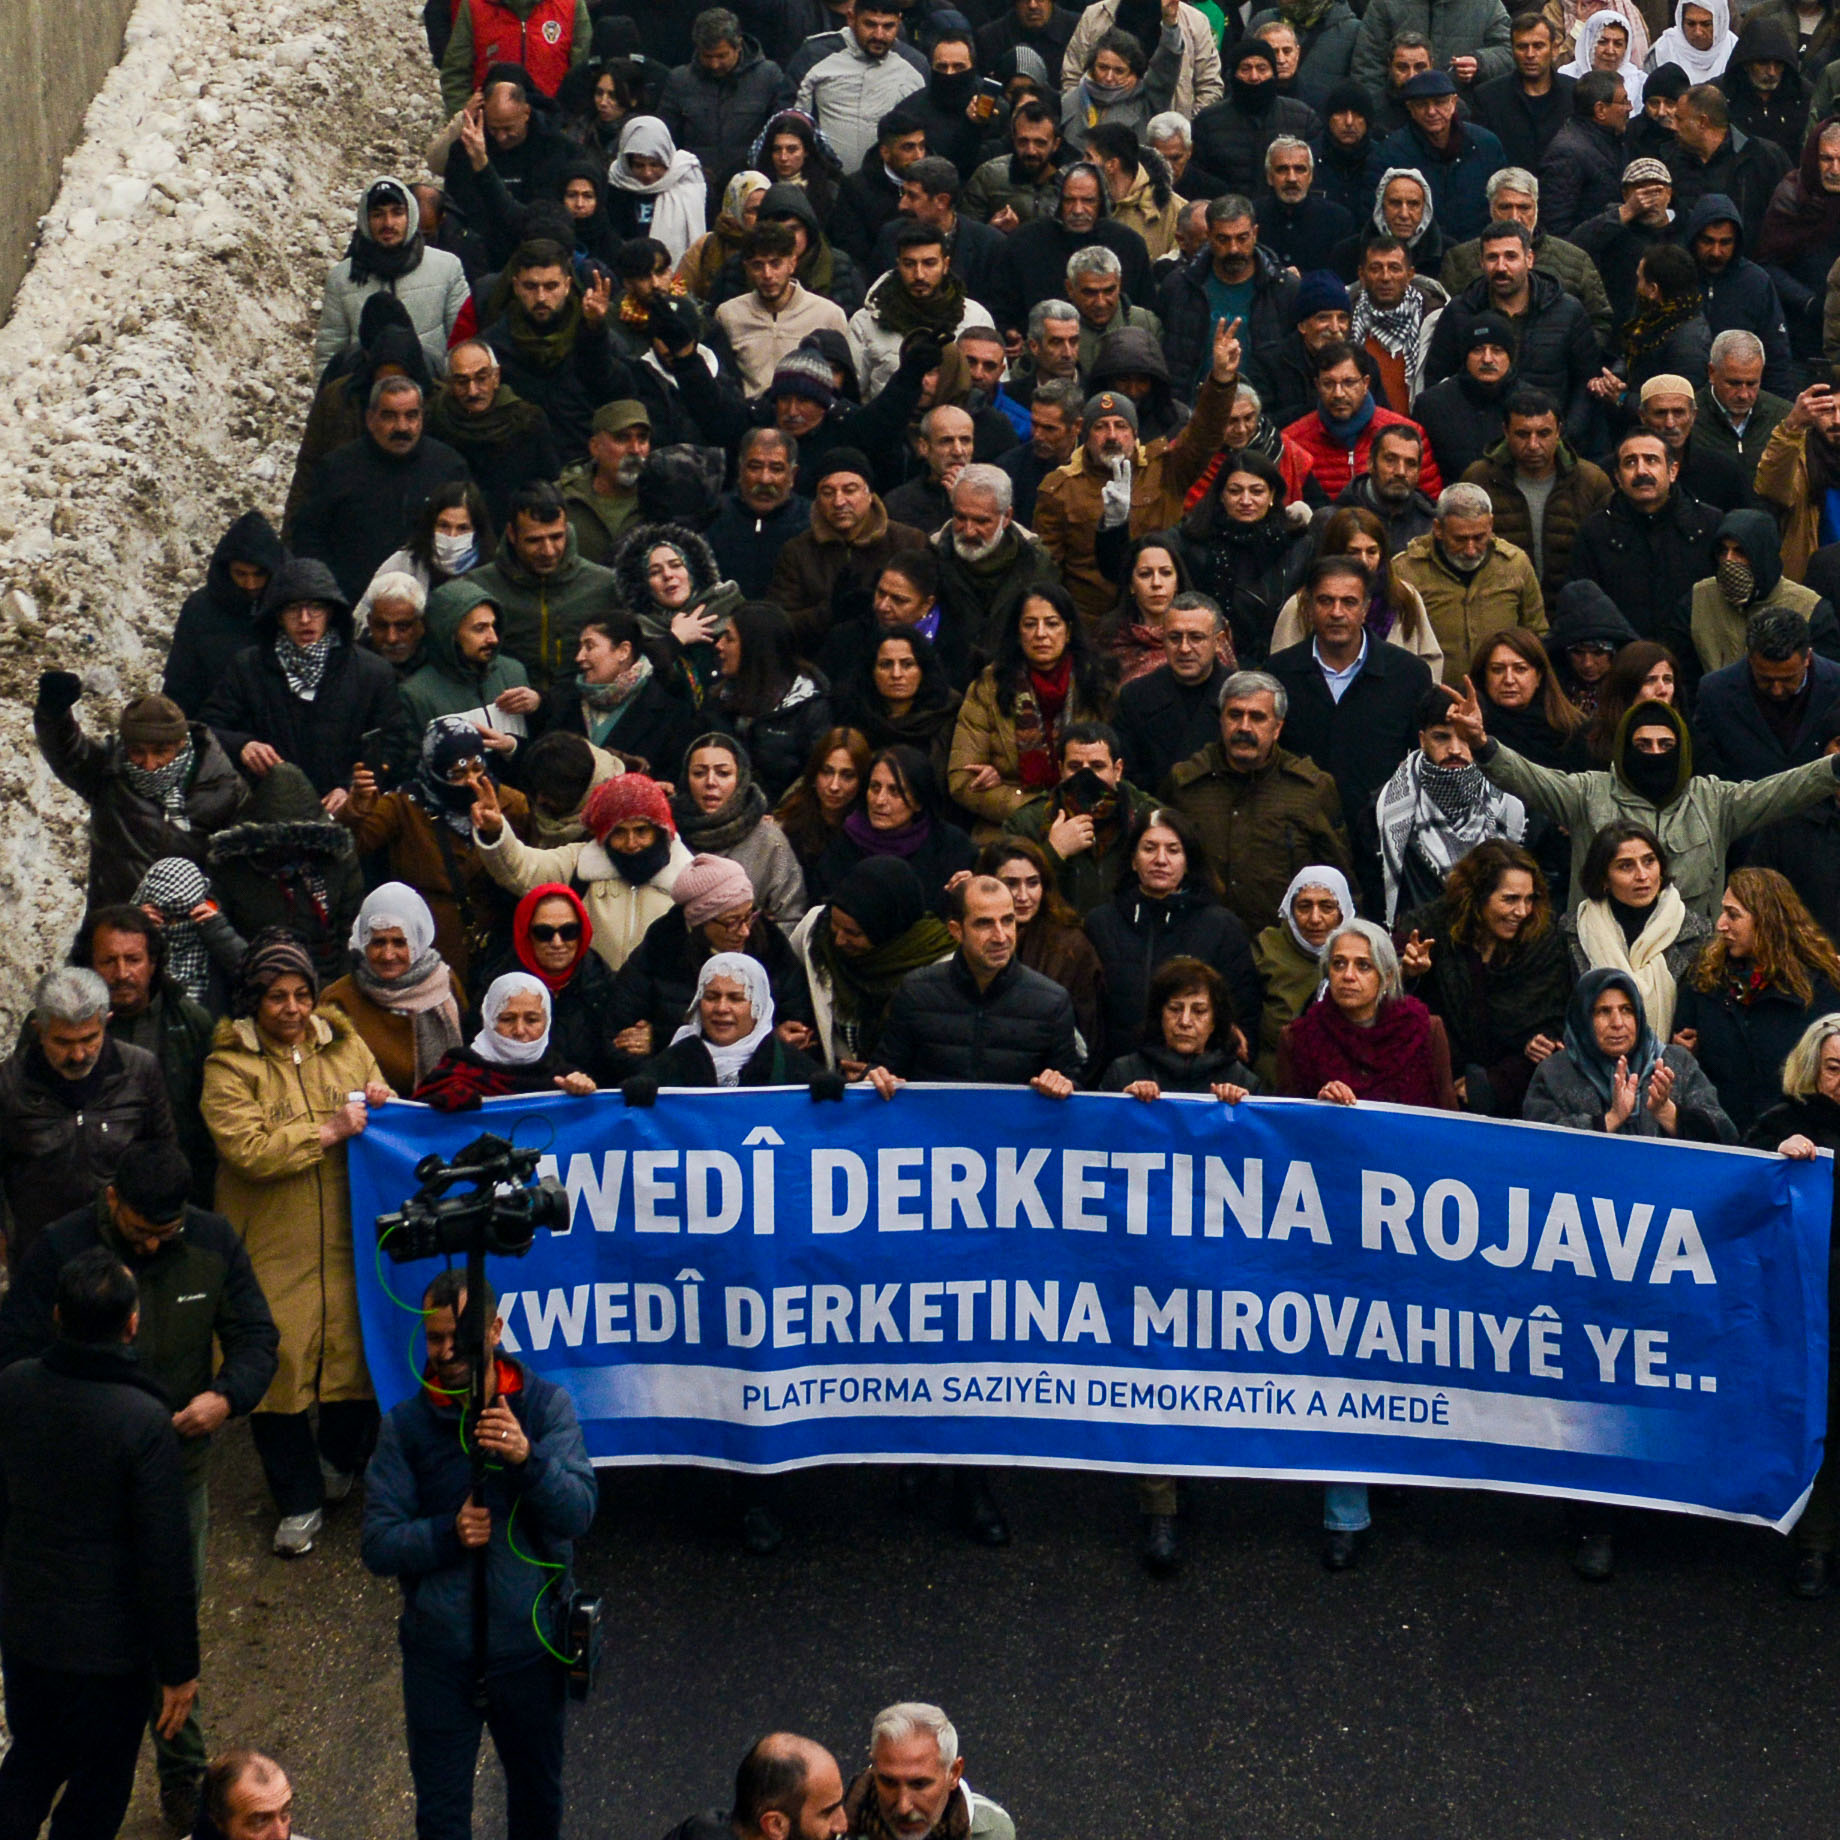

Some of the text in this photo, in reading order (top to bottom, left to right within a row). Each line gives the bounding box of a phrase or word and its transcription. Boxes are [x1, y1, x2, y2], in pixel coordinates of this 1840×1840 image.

[496, 1126, 1718, 1286] WEDÎ DERKETINA ROJAVA
[725, 1278, 1112, 1349] DERKETINA
[1133, 1286, 1564, 1380] MIROVAHIYÊ
[1583, 1323, 1718, 1394] YE..
[742, 1370, 1451, 1427] PLATFORMA SAZIYÊN DEMOKRATÎK A AMEDÊ
